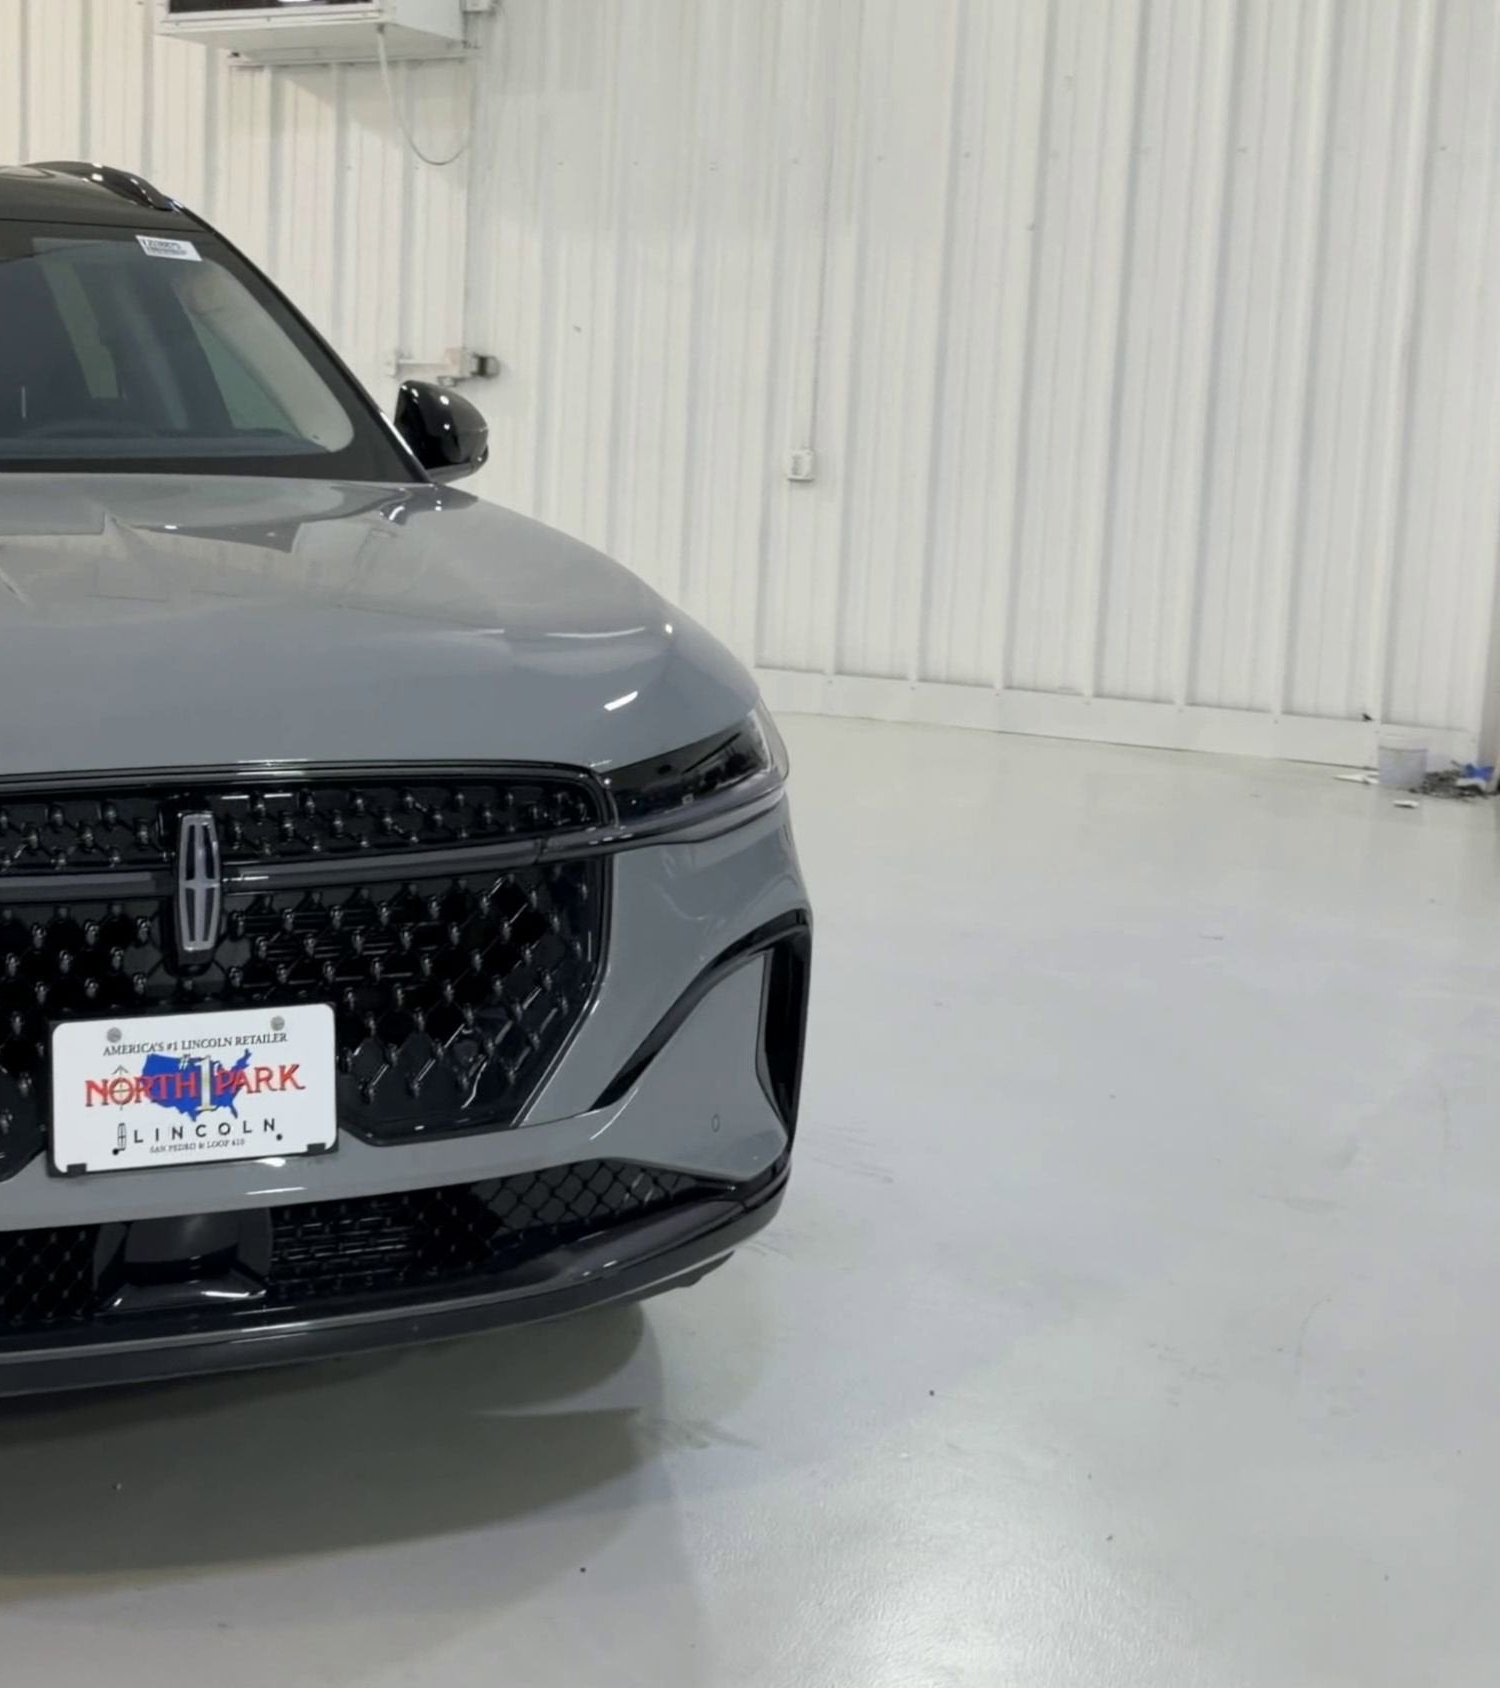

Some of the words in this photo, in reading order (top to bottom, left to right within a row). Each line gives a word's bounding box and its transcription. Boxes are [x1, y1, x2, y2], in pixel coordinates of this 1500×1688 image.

[102, 1042, 165, 1057] AMERICA'S
[166, 1041, 178, 1051] #1
[181, 1036, 233, 1051] LINCOLN
[235, 1032, 288, 1047] RETAILER
[84, 1071, 197, 1107] NORTH
[215, 1064, 307, 1098] PARK
[133, 1118, 277, 1144] LINCOLN
